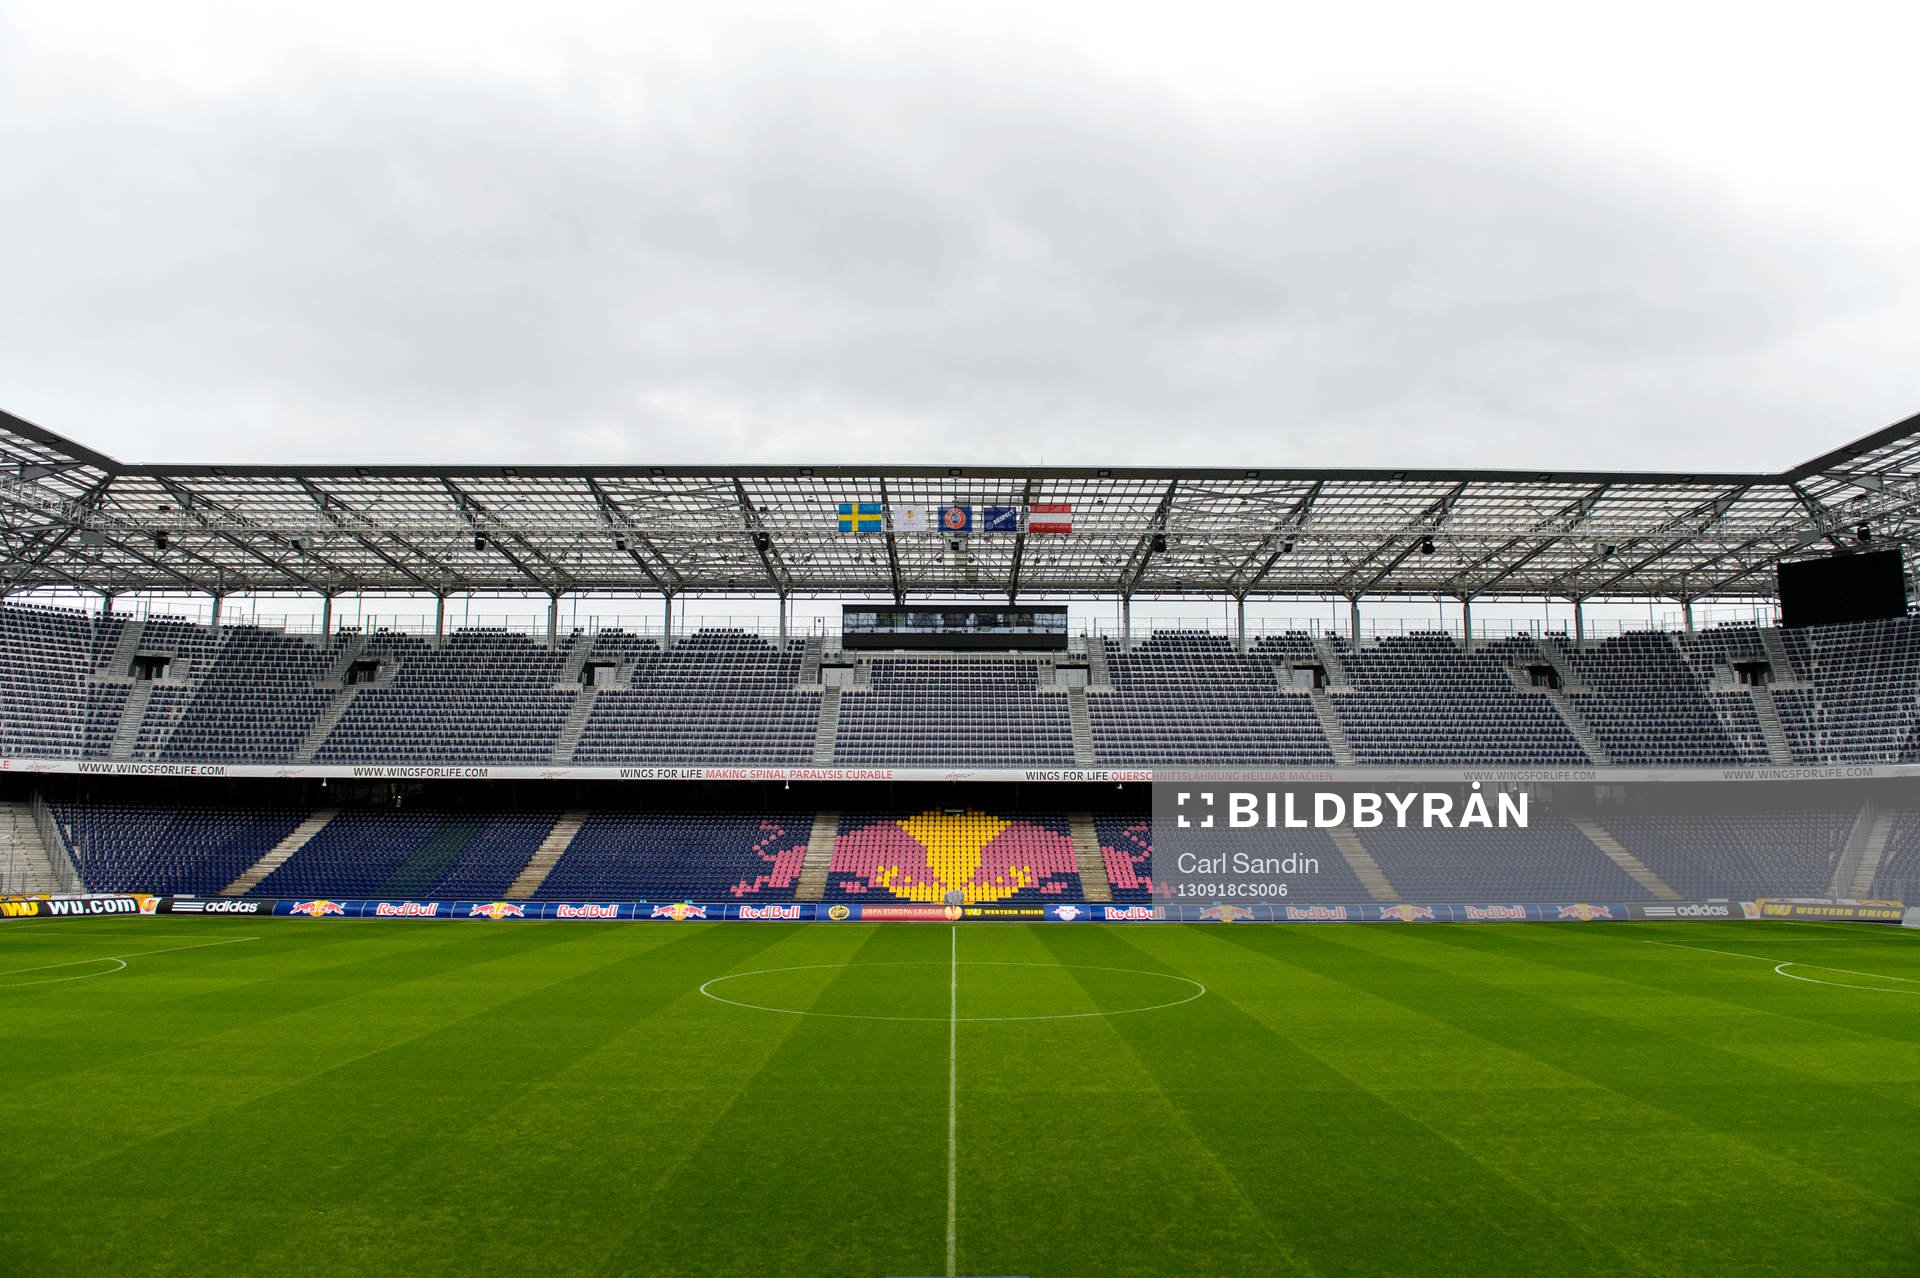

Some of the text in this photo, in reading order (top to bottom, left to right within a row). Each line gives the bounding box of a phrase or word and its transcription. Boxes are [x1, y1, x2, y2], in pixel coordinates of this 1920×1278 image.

[78, 763, 225, 775] WWW.WINGSFORLIFE.COM
[353, 767, 489, 777] WWW.WINGSFORLIFE.COM
[620, 769, 893, 779] WINGS FOR LIFE MAKING SPINAL PARALYSIS CURABLE
[1723, 767, 1873, 780] WWW.WINGSFORLIFE.COM
[1025, 771, 1060, 780] WINGS
[1063, 771, 1084, 780] FOR
[1087, 771, 1108, 780] LIFE
[1243, 772, 1286, 781] HEILBAR
[1289, 772, 1333, 781] MACHEN
[1463, 771, 1596, 780] WWW.WINGSFORLIFE.COM
[205, 900, 259, 913] adidas
[1676, 904, 1728, 916] adidas
[1795, 907, 1853, 916] WESTERN
[1858, 909, 1900, 918] UNION
